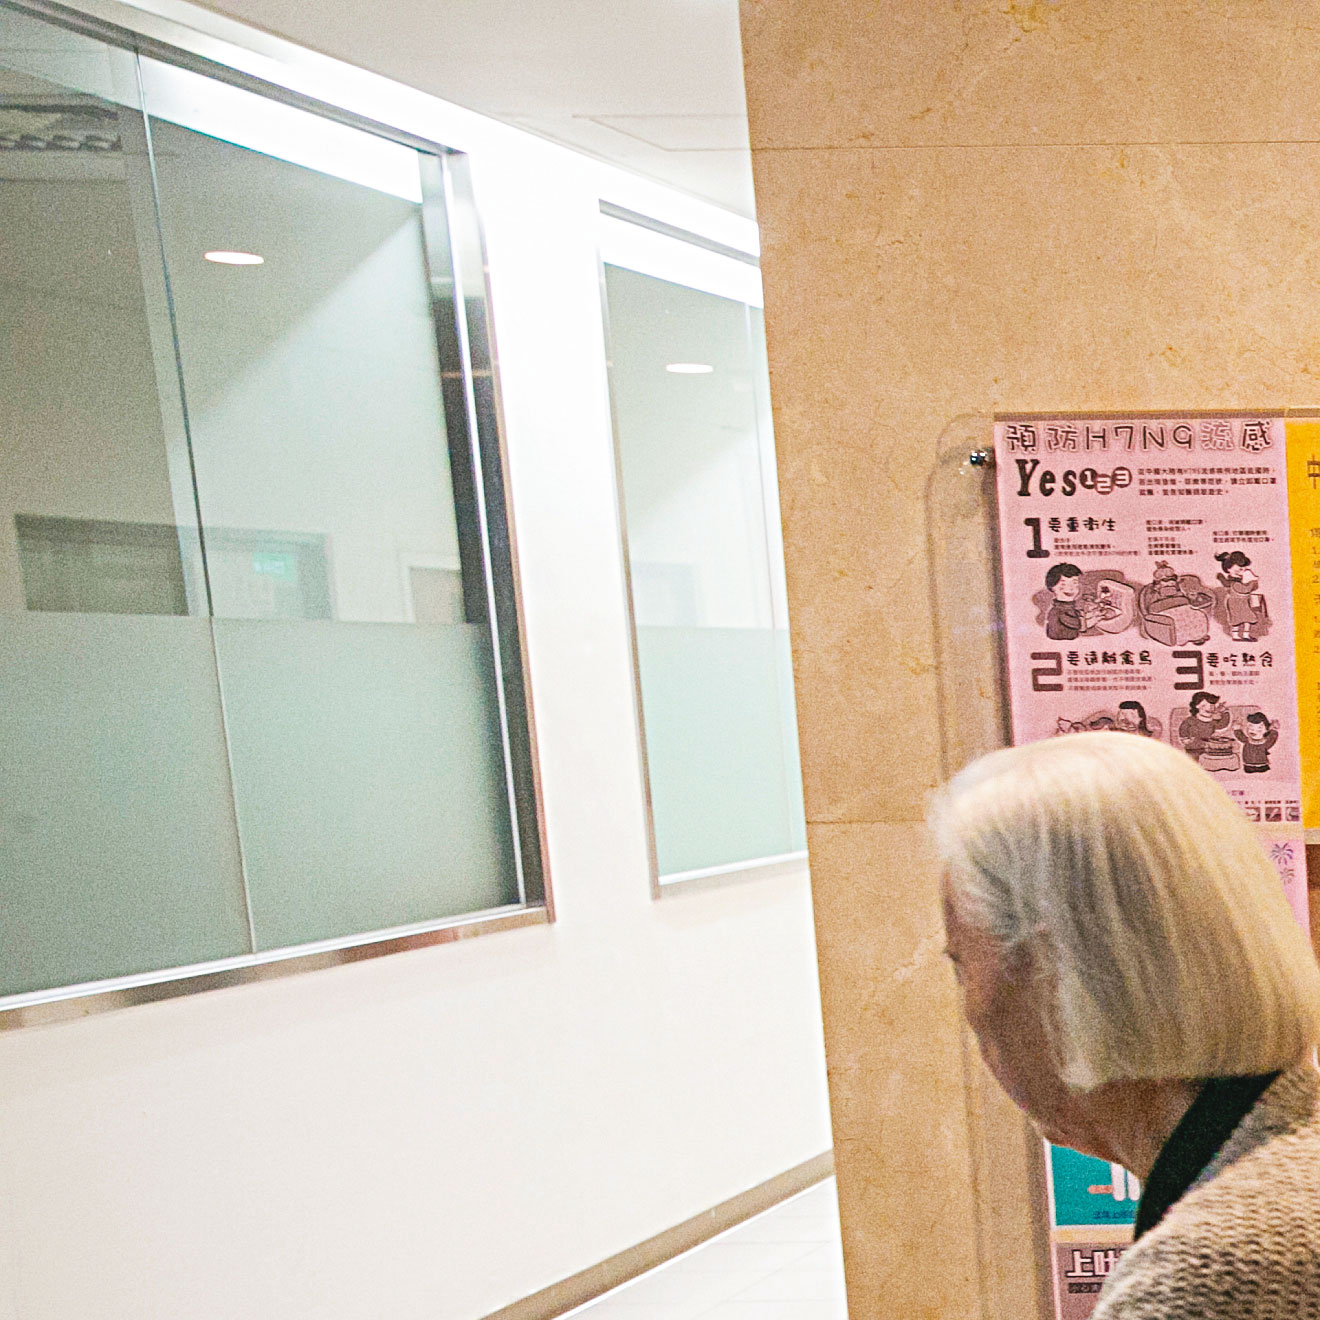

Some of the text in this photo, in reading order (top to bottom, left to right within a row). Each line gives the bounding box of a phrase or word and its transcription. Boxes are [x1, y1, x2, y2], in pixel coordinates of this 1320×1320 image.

[1005, 420, 1273, 452] 預防H7N9流感
[1023, 517, 1050, 558] 1
[1030, 651, 1064, 692] 2
[1171, 650, 1204, 690] 3
[1206, 650, 1273, 668] 要吃熟食
[1064, 1247, 1127, 1278] 上吐
